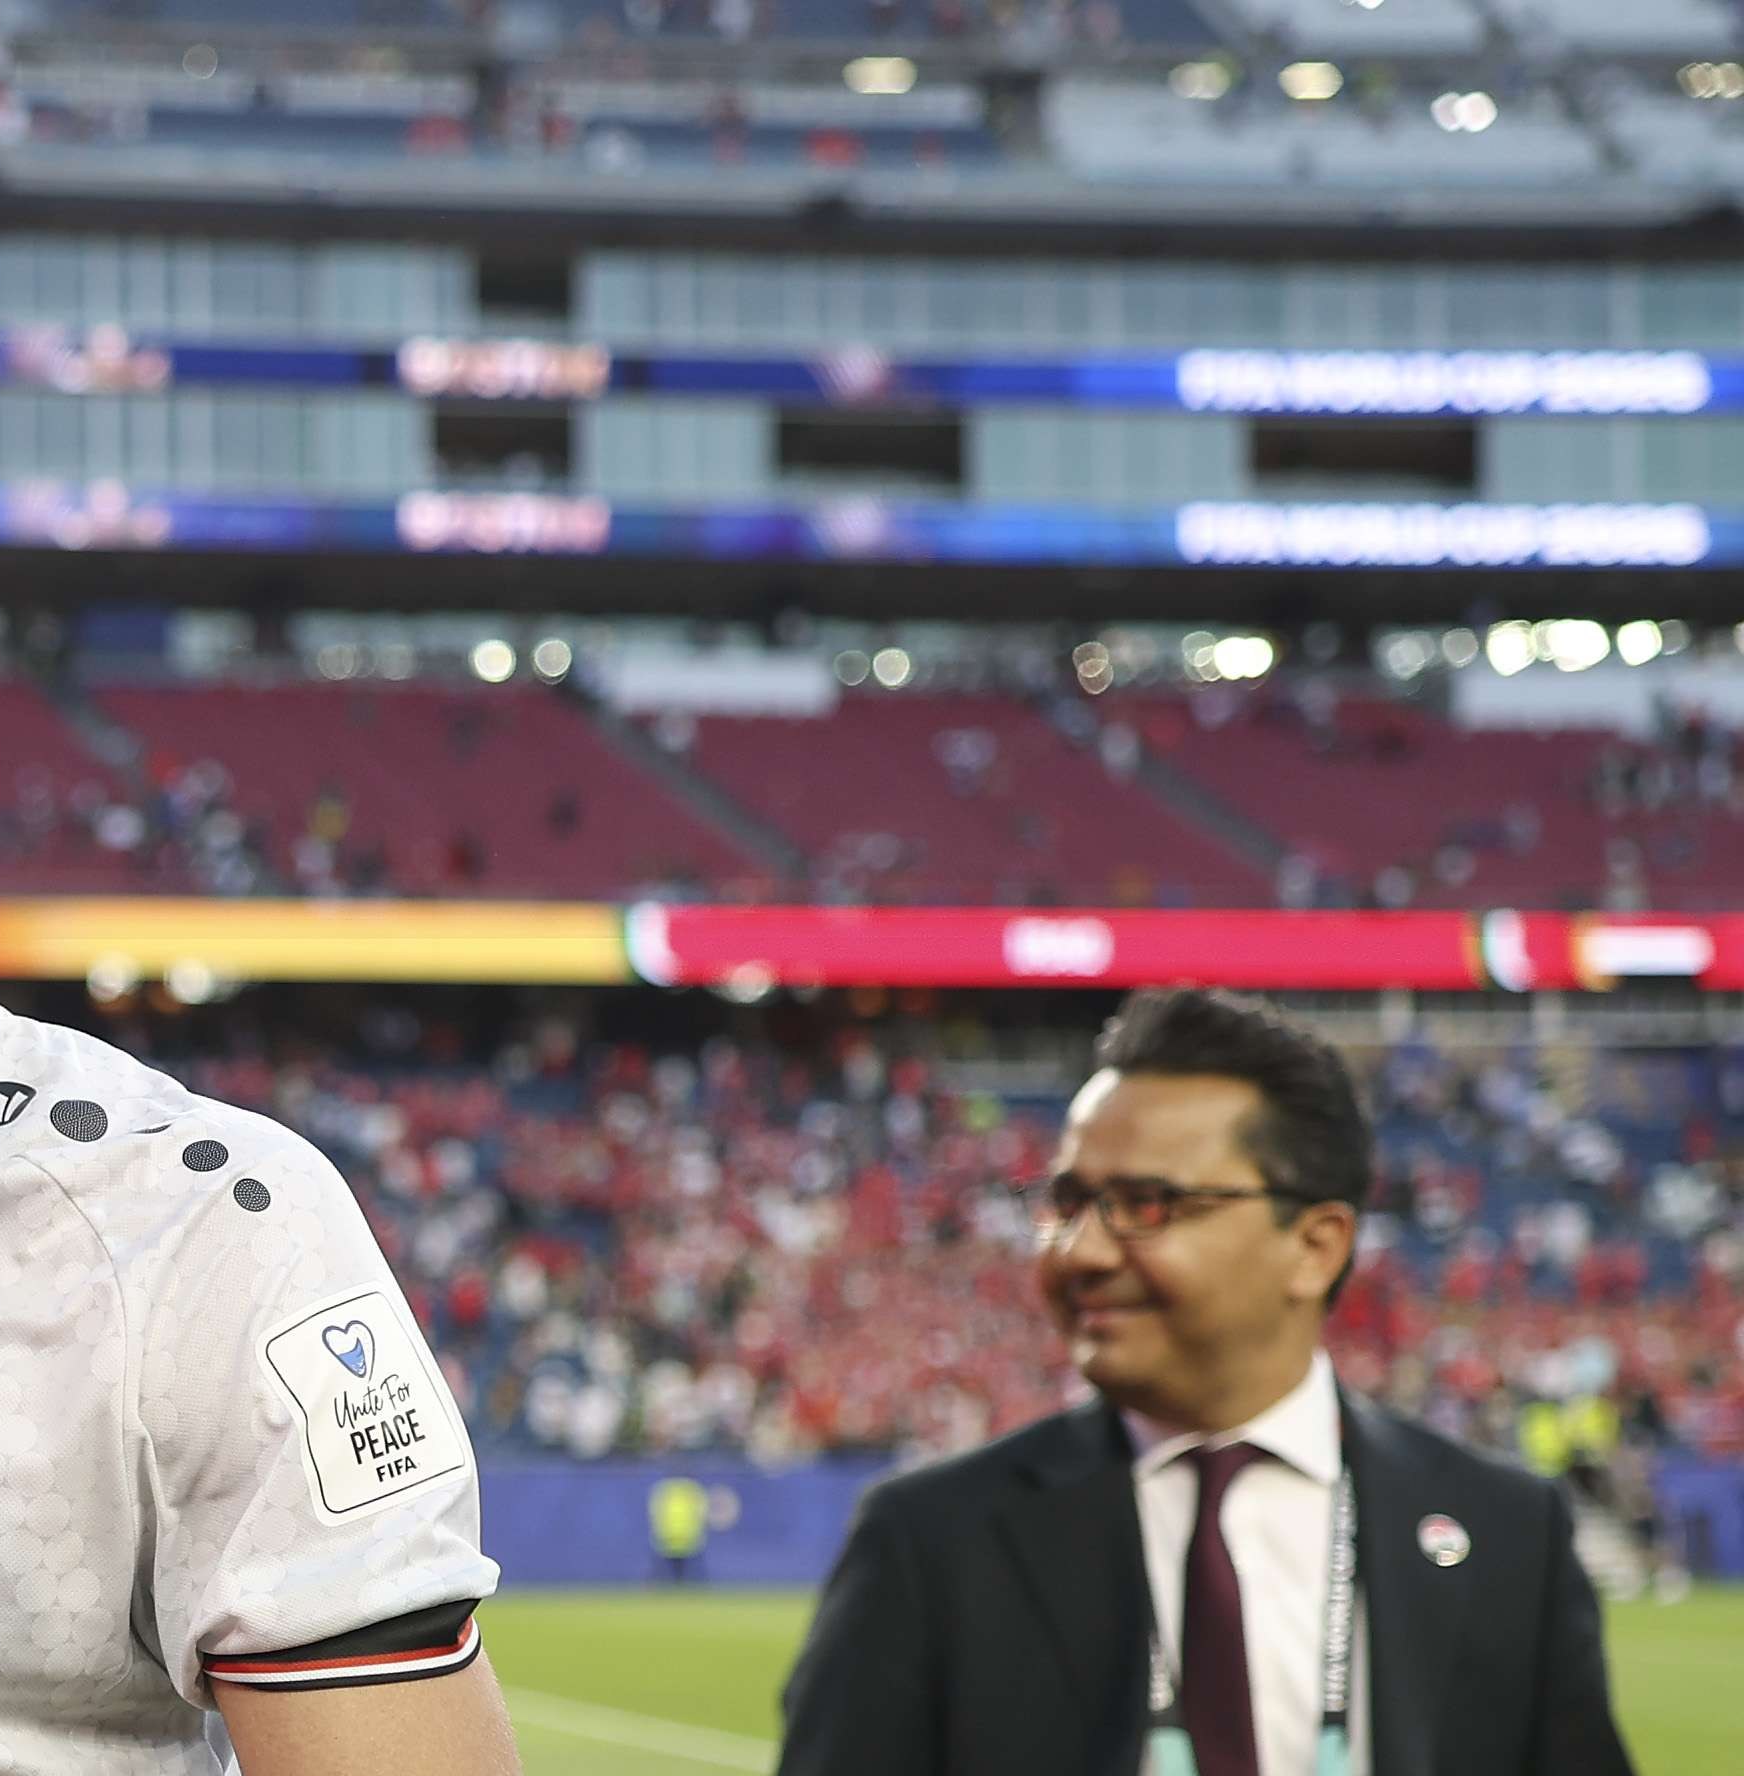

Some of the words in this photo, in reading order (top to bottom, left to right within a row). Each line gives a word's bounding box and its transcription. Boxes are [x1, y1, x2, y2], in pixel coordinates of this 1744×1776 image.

[334, 1387, 383, 1430] Unite
[380, 1374, 411, 1411] For
[350, 1408, 426, 1465] PEACE
[376, 1456, 417, 1483] FIFA
